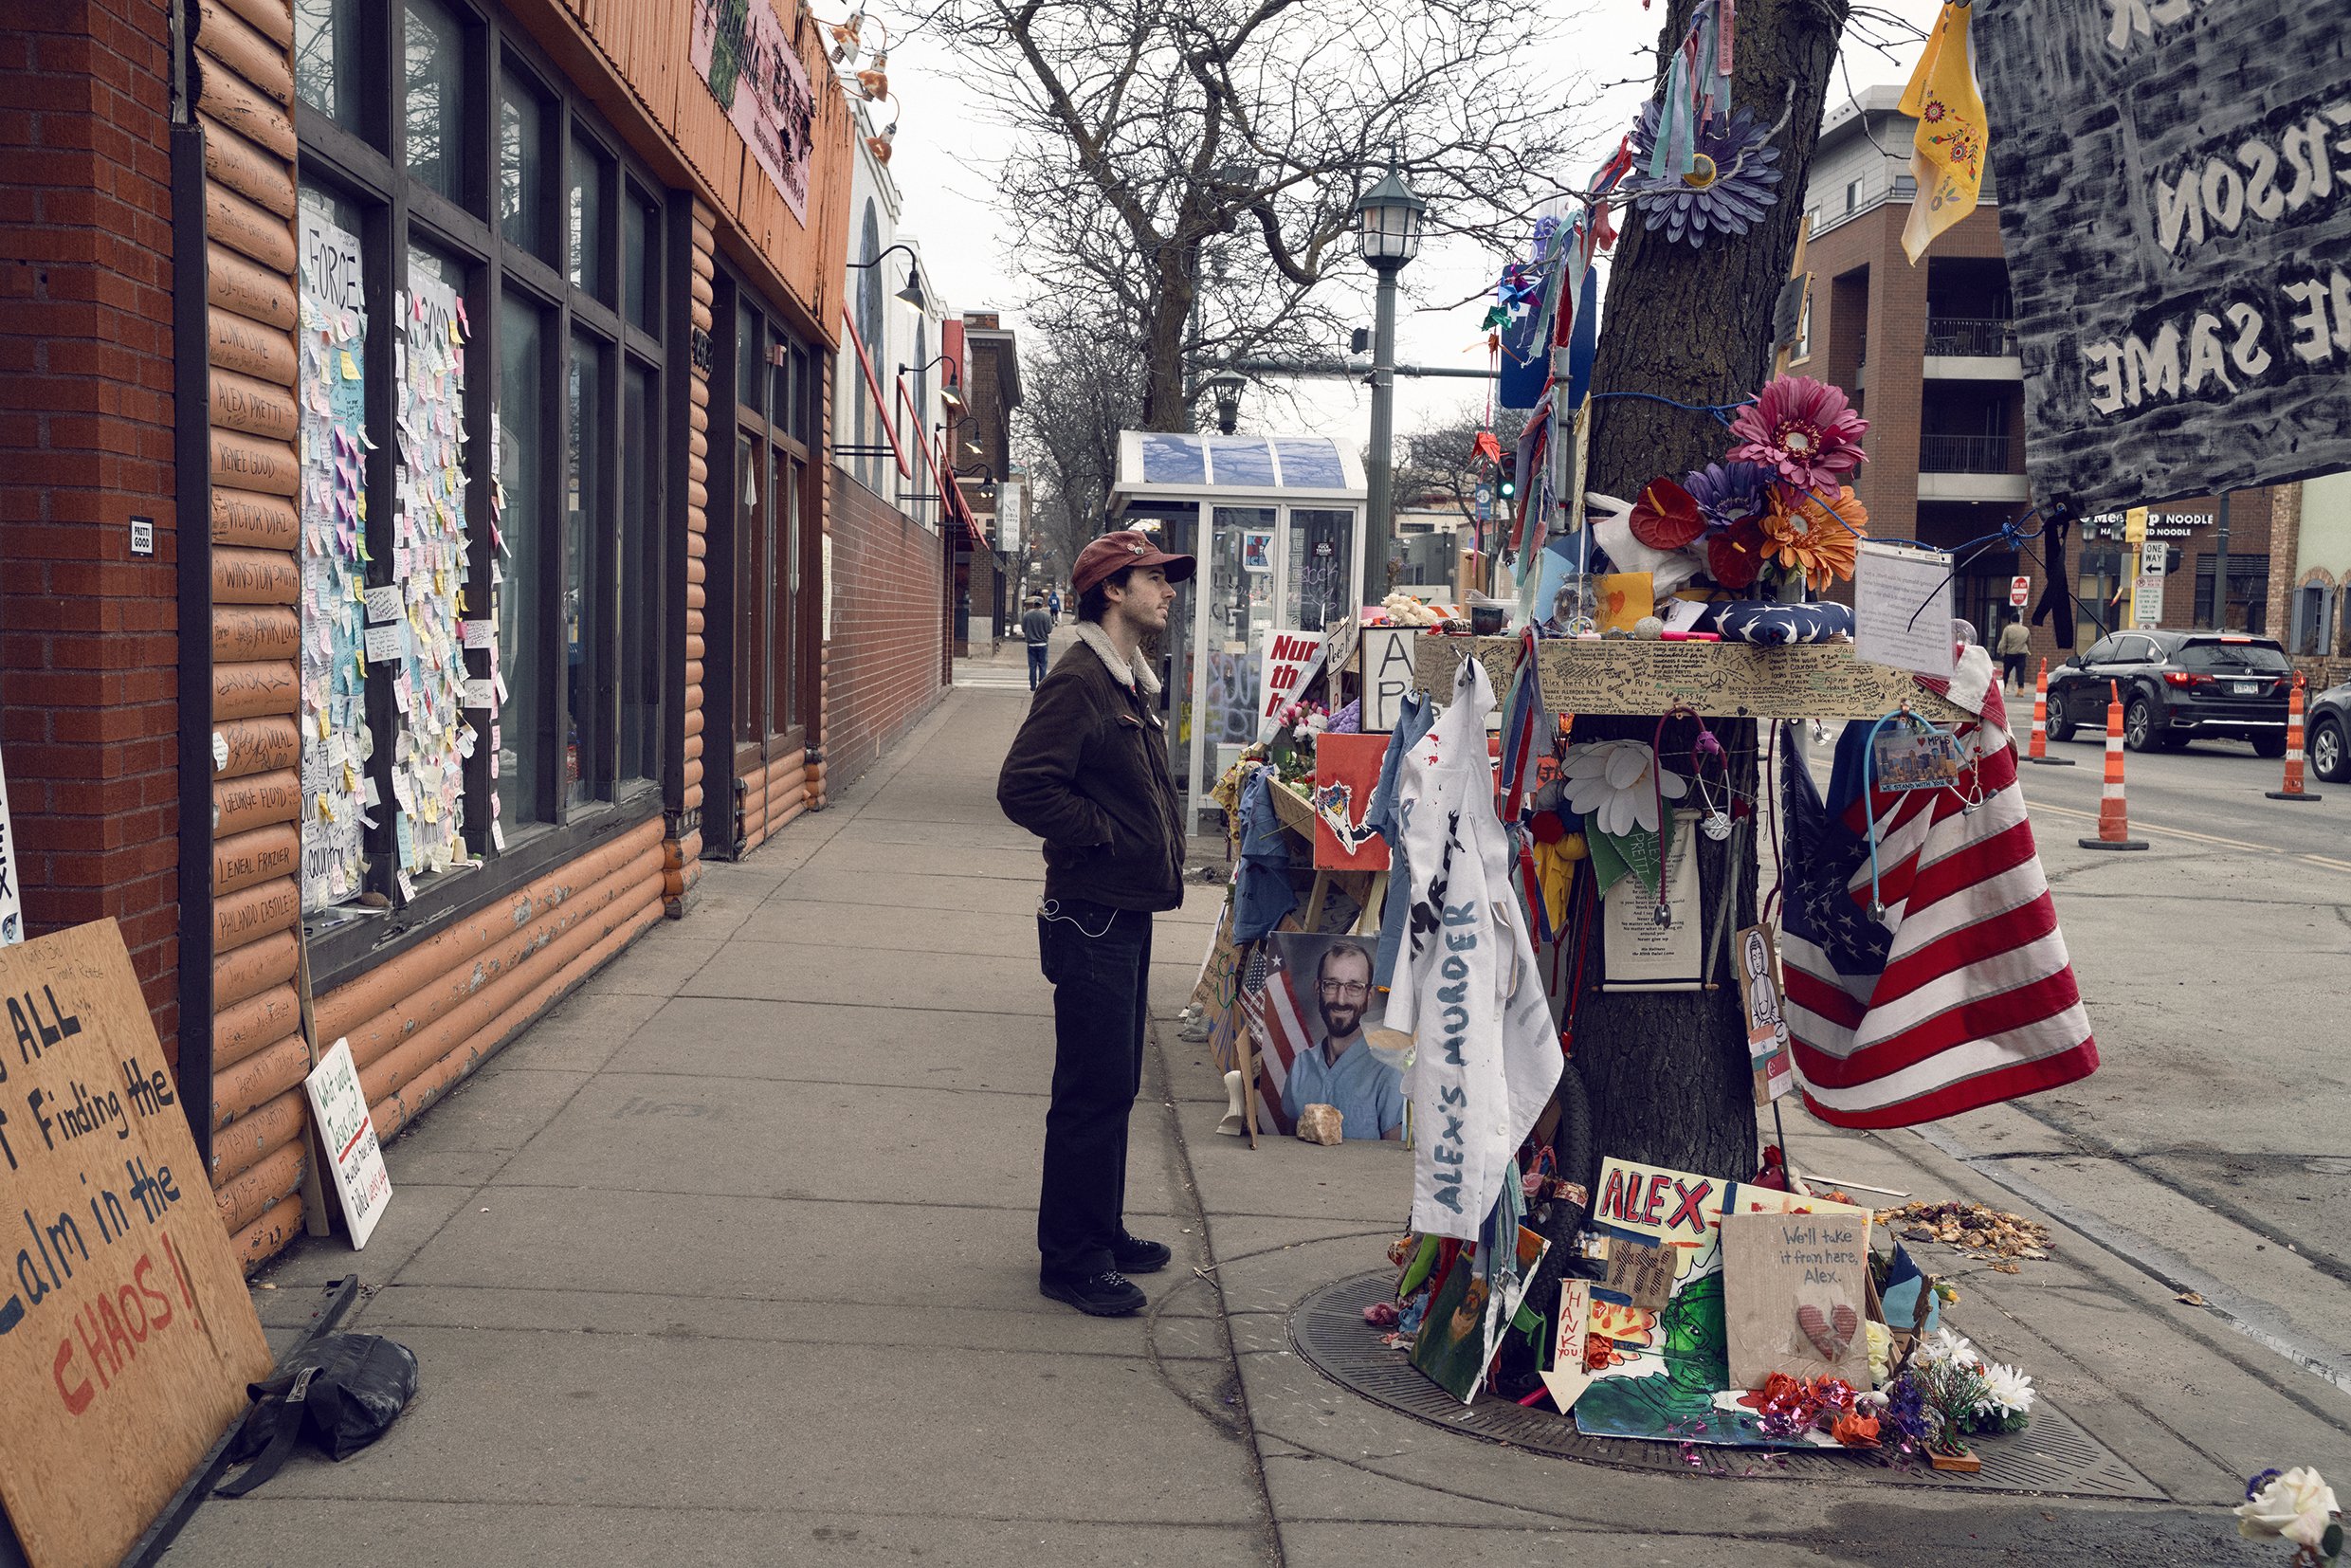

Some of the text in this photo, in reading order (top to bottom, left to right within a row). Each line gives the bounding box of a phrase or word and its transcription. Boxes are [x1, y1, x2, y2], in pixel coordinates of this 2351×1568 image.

[309, 228, 359, 316] FORCE
[245, 327, 269, 360] LIVE
[216, 380, 282, 424] ALEX PRETTI
[218, 442, 275, 479] RENEE GOOD
[135, 526, 150, 537] PRETTI
[224, 498, 289, 535] VICTOR DIAZ
[2166, 514, 2214, 524] NOODLE
[135, 537, 150, 548] GOOD
[2145, 554, 2163, 563] WAY
[2146, 544, 2162, 553] ONE
[223, 560, 298, 592] WINSTON SMITH
[253, 614, 279, 648] AMIR
[1542, 678, 1559, 687] Alex
[1562, 678, 1585, 687] Pretti
[1880, 679, 1894, 693] You
[1895, 675, 1908, 686] are
[1927, 735, 1951, 746] MPLS
[220, 785, 287, 814] GEORGE FLOYD
[219, 847, 290, 884] LENEAL FRAZIER
[308, 835, 344, 879] country
[1630, 833, 1650, 876] PRETTI
[1648, 832, 1661, 866] ALEX
[219, 895, 290, 939] PHILANDO CASTILE
[1437, 901, 1478, 1067] MURDER
[7, 984, 82, 1065] ALL
[236, 1048, 296, 1101] Breonna Taylor
[27, 1057, 174, 1151] Finding the
[218, 1101, 289, 1158] TRAYVON MARTIN
[327, 1117, 350, 1155] Jesus
[1433, 1085, 1467, 1215] ALEX'S
[80, 1172, 131, 1245] in
[126, 1156, 181, 1225] the
[1600, 1167, 1714, 1234] ALEX
[1782, 1226, 1852, 1245] We'll take
[1779, 1249, 1858, 1266] it from here,
[1804, 1267, 1842, 1285] Alex.
[53, 1231, 200, 1416] CHAOS!
[1561, 1280, 1581, 1348] THANK
[1558, 1348, 1582, 1360] YOU!
